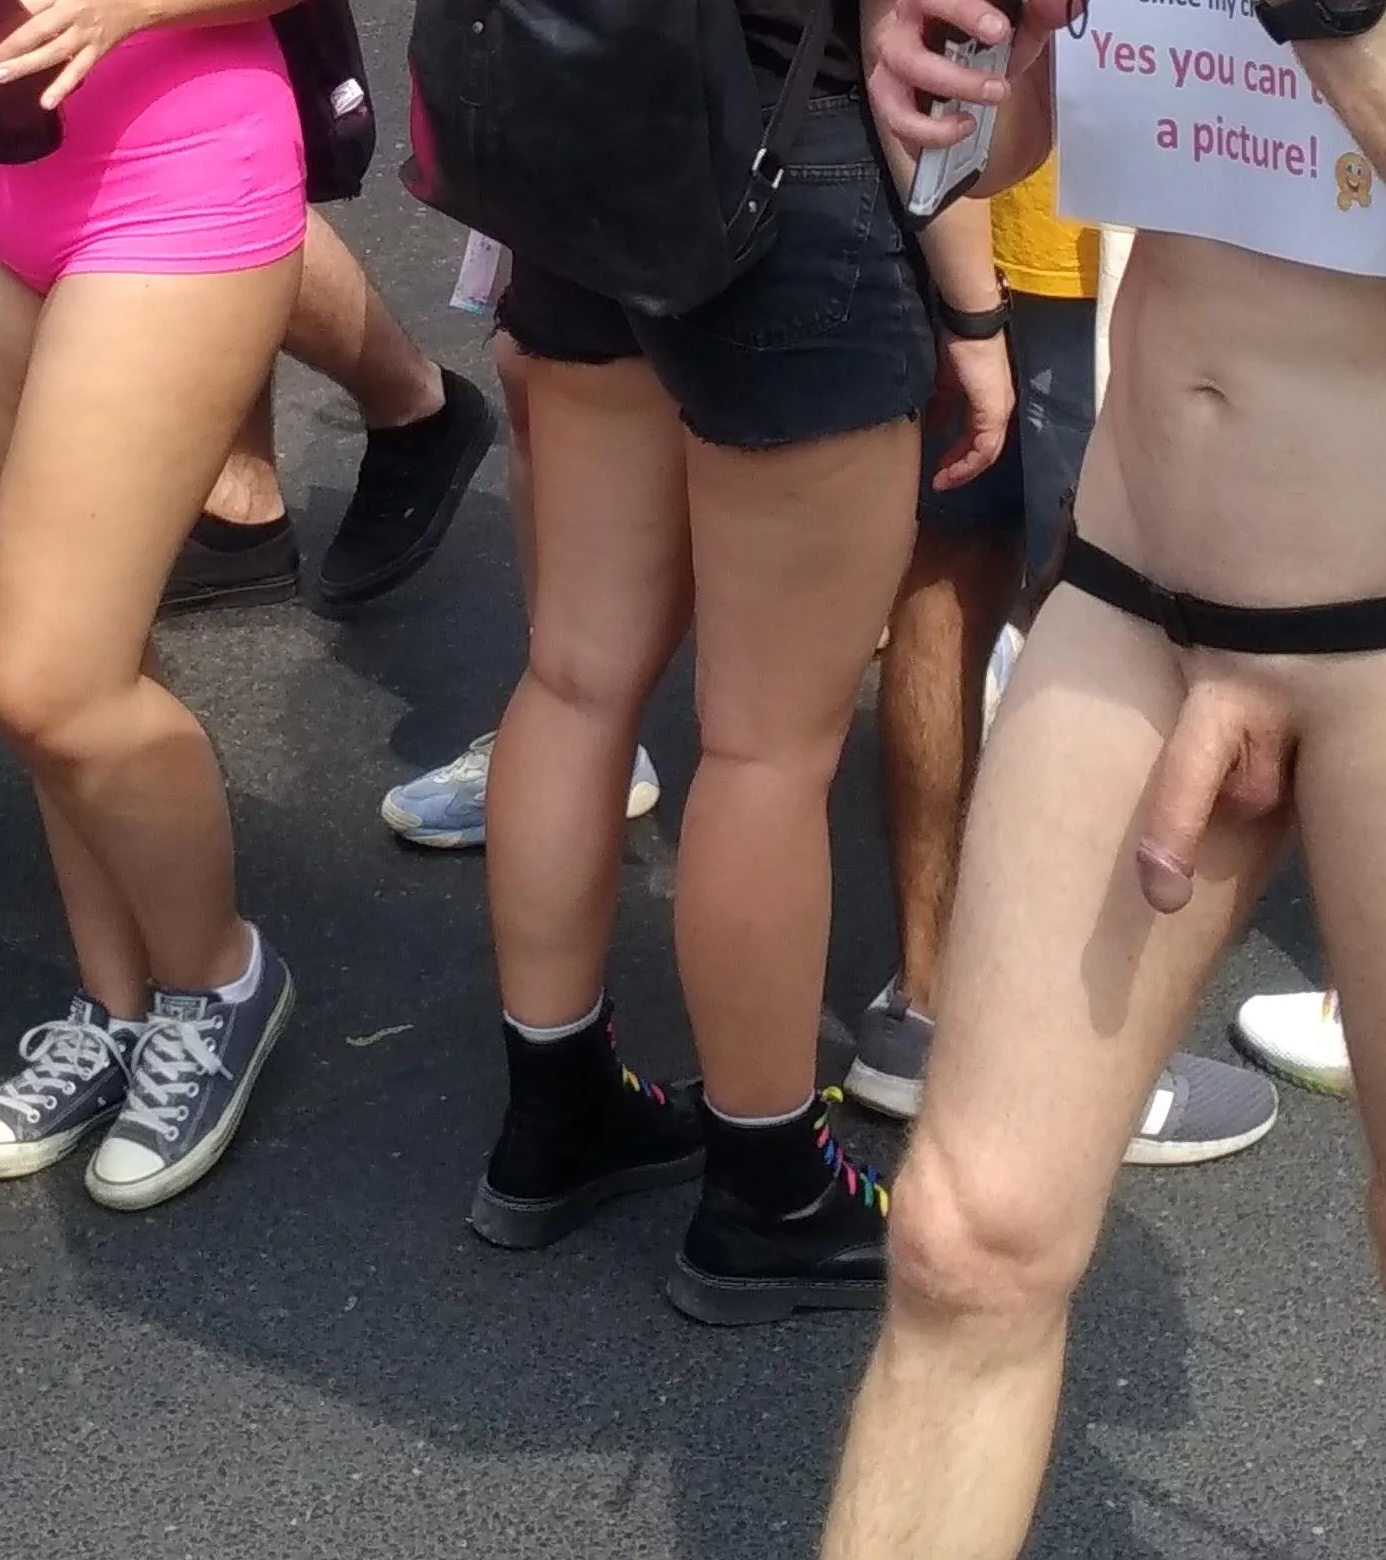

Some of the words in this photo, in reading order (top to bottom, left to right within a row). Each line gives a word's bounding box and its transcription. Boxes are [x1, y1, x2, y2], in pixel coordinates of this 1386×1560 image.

[1091, 29, 1157, 75] Yes
[1169, 47, 1235, 88] you
[1244, 60, 1297, 100] can
[1156, 118, 1179, 149] a
[1192, 115, 1318, 179] picture!
